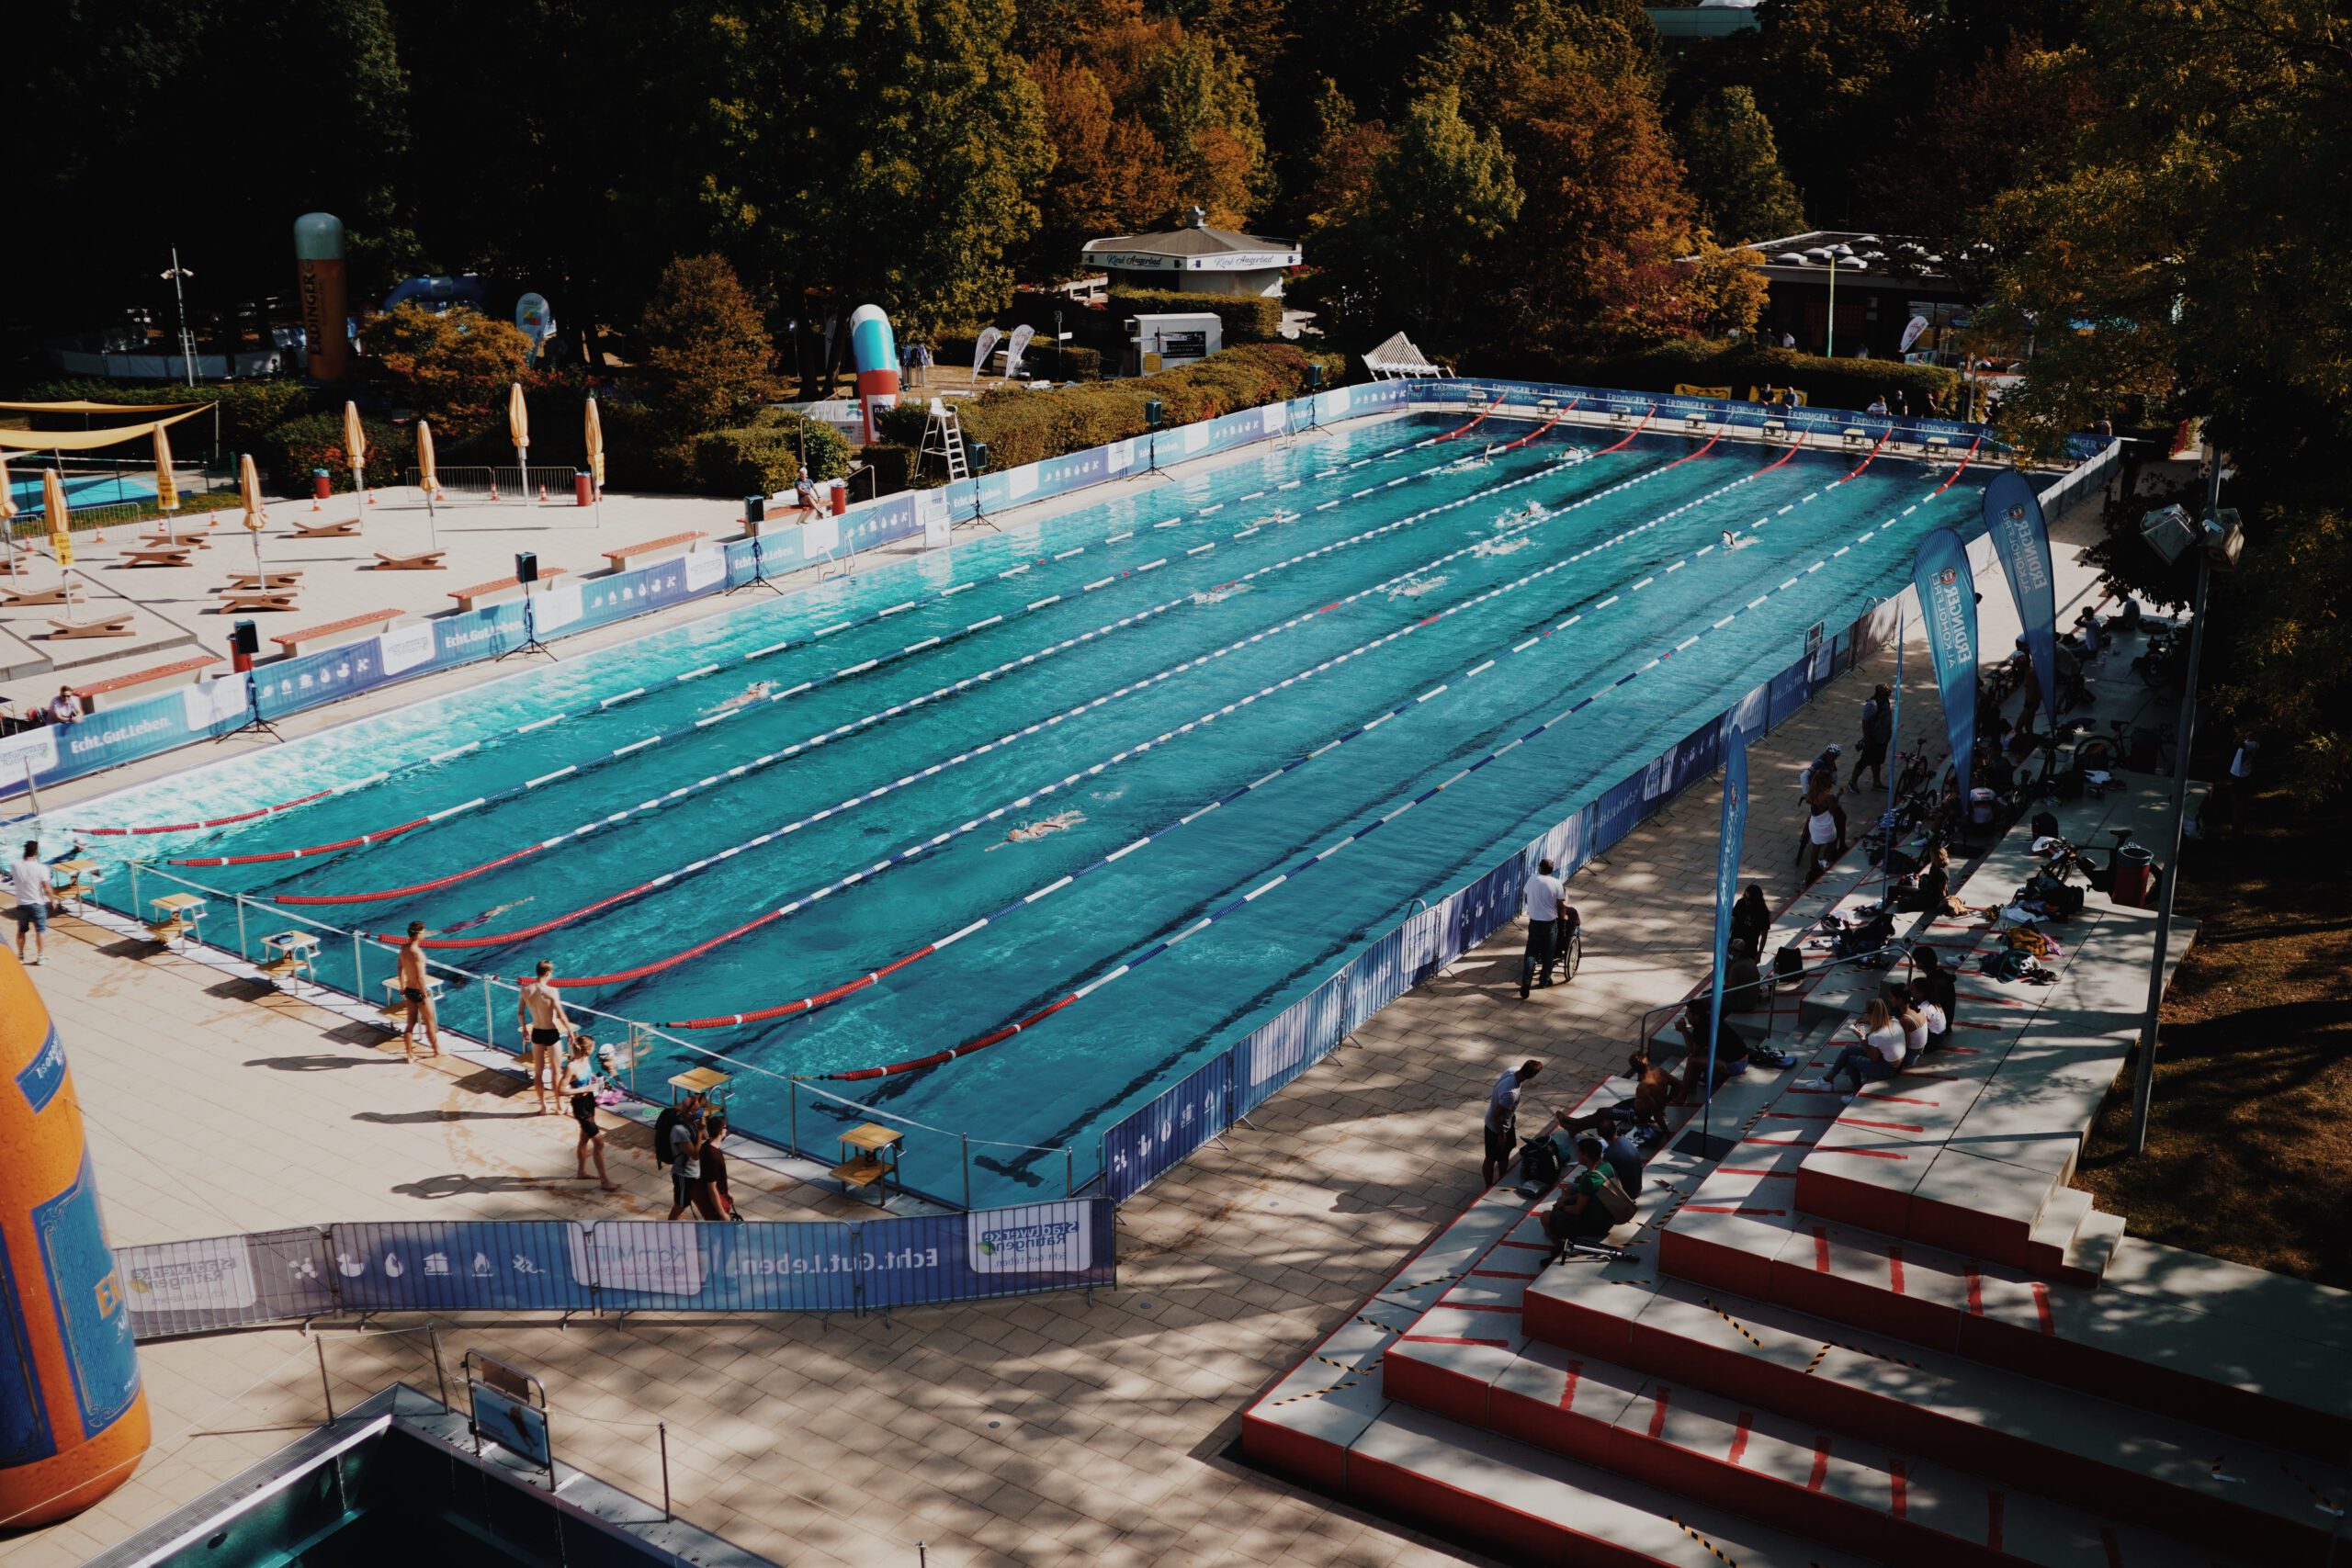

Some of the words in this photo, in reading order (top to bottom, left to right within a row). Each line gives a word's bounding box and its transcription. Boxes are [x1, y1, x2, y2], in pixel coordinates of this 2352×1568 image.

[1107, 254, 1125, 265] Kiosk
[1126, 255, 1162, 266] Angerbad
[1215, 257, 1234, 268] Kiosk
[1236, 255, 1274, 266] Angerbad
[303, 274, 323, 355] ERDINGER
[1492, 383, 1531, 394] ERDINGER
[1549, 388, 1588, 399] ERDINGER
[1607, 393, 1645, 404] ERDINGER
[1666, 399, 1706, 410] ERDINGER
[1726, 404, 1767, 415] ERDINGER
[1788, 410, 1829, 422] ERDINGER
[1851, 416, 1893, 428] ERDINGER
[1916, 423, 1958, 434] ERDINGER
[71, 716, 173, 754] Echt.Gut.Leben.
[284, 950, 292, 961] 4
